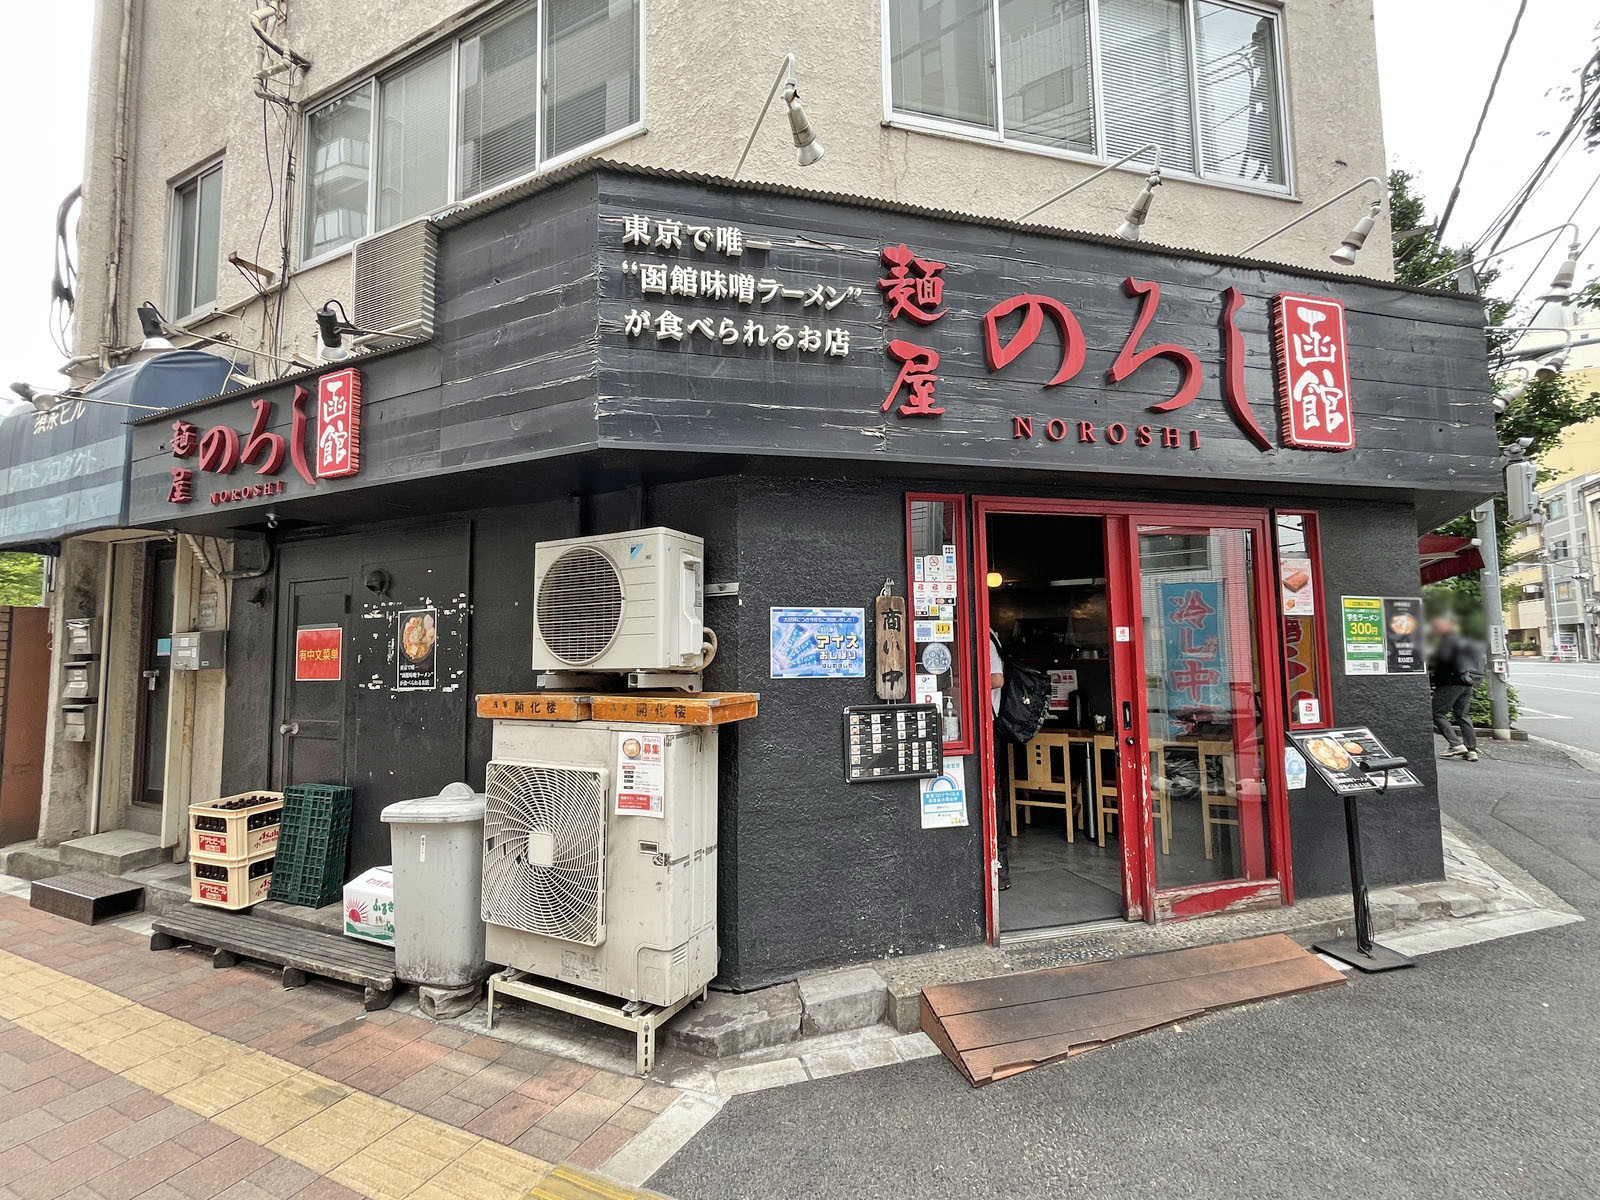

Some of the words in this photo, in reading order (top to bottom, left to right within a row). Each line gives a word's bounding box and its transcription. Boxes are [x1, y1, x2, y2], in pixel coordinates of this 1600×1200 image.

[621, 213, 773, 257] 東京で唯一
[624, 308, 850, 358] が食べられるお店
[981, 276, 1274, 453] のろし
[1291, 305, 1344, 434] 函館
[198, 383, 316, 486] のろし
[319, 380, 349, 468] 函館
[1011, 414, 1201, 451] NOROSHI
[208, 480, 286, 505] NOROSHI
[816, 634, 860, 650] アイス
[1350, 622, 1379, 635] 300円
[299, 648, 340, 662] 有中文菜单
[820, 650, 857, 660] おしぼり
[881, 607, 904, 691] 商い中
[643, 743, 660, 755] 募集
[200, 836, 227, 846] アサヒビール
